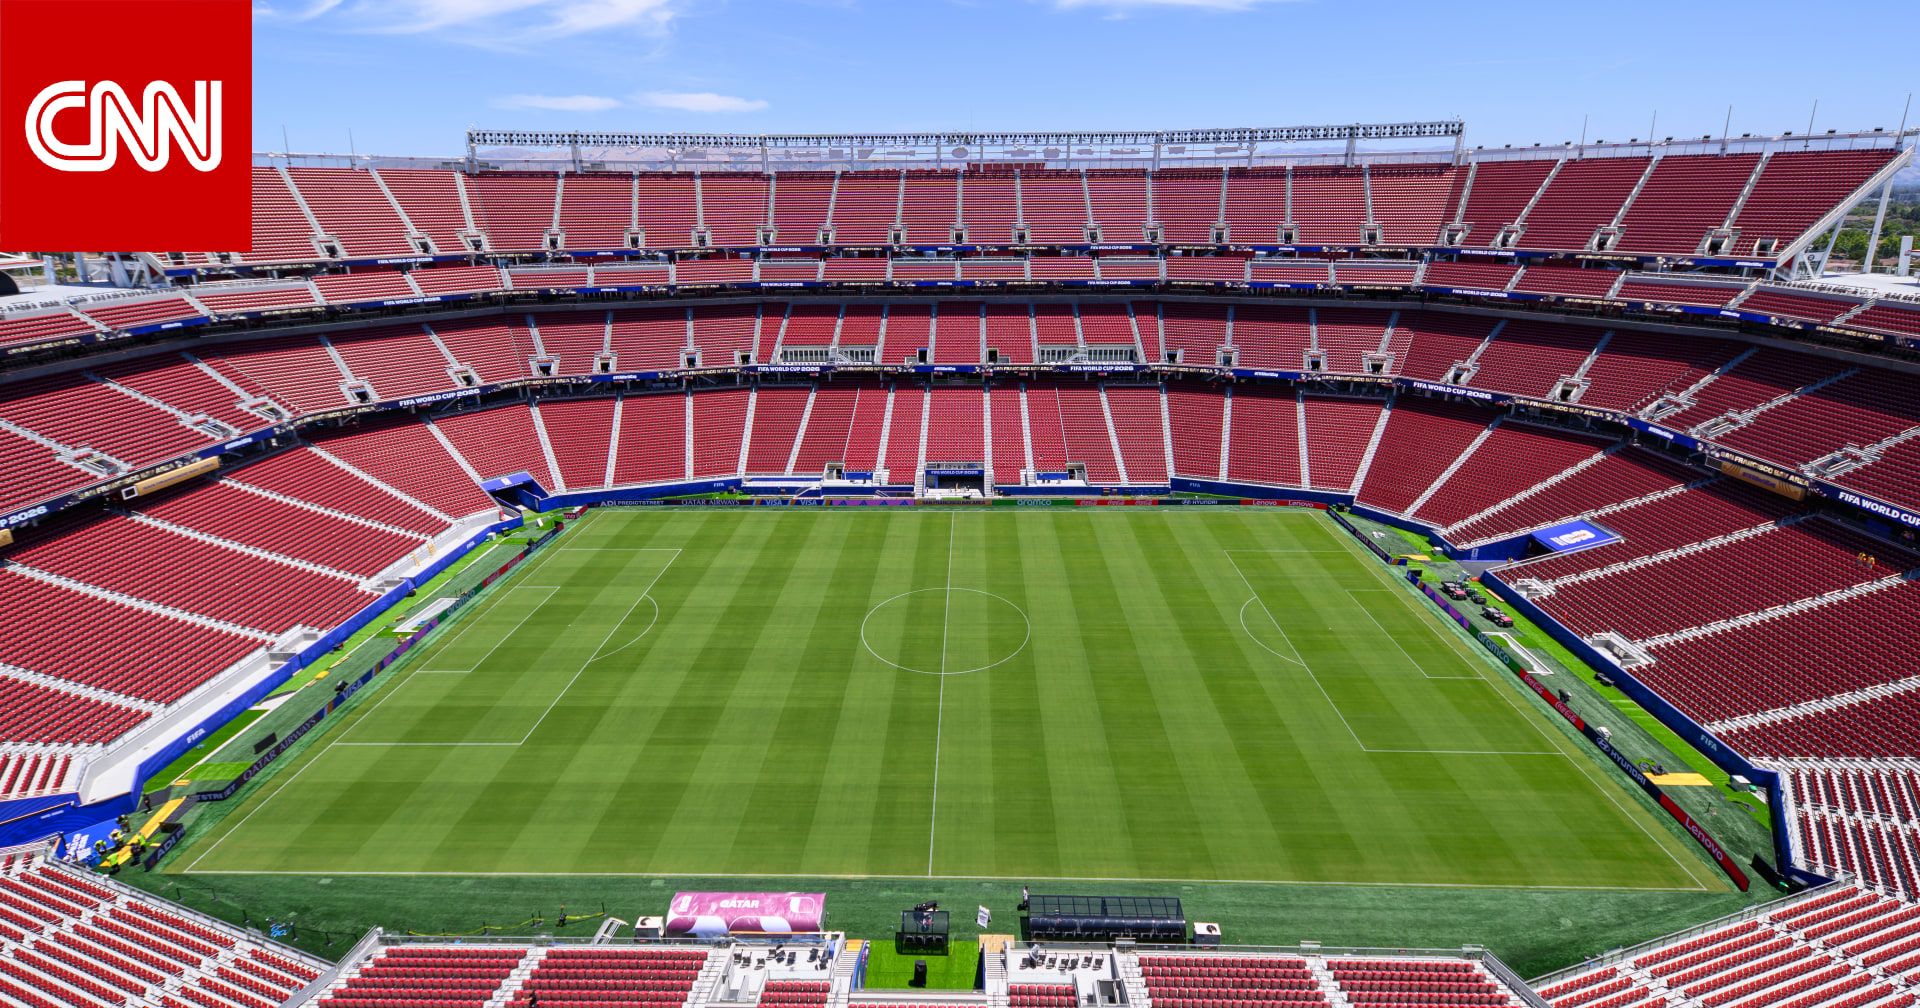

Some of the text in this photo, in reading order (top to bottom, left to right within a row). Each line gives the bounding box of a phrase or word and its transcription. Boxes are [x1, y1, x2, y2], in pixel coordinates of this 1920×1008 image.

[399, 399, 415, 408] FIFA
[416, 395, 441, 405] WORLD
[457, 388, 480, 397] 2026
[1413, 381, 1427, 389] FIFA
[1428, 384, 1452, 394] WORLD
[1467, 391, 1491, 400] 2026
[1789, 475, 1809, 487] AREA
[1289, 500, 1314, 508] Lenovo
[1838, 491, 1861, 506] FIFA
[1861, 497, 1900, 518] WORLD
[8, 505, 48, 524] 2026
[446, 590, 476, 617] aramco
[1478, 632, 1511, 665] aramco
[342, 679, 364, 699] VISA
[186, 728, 206, 744] FIFA
[1700, 734, 1719, 752] FIFA
[243, 718, 317, 782] QATAR AIRWAYS
[1610, 751, 1648, 787] HYUNDAI
[157, 836, 177, 860] ADI
[1684, 816, 1724, 862] Lenovo
[719, 899, 761, 909] QATAR
